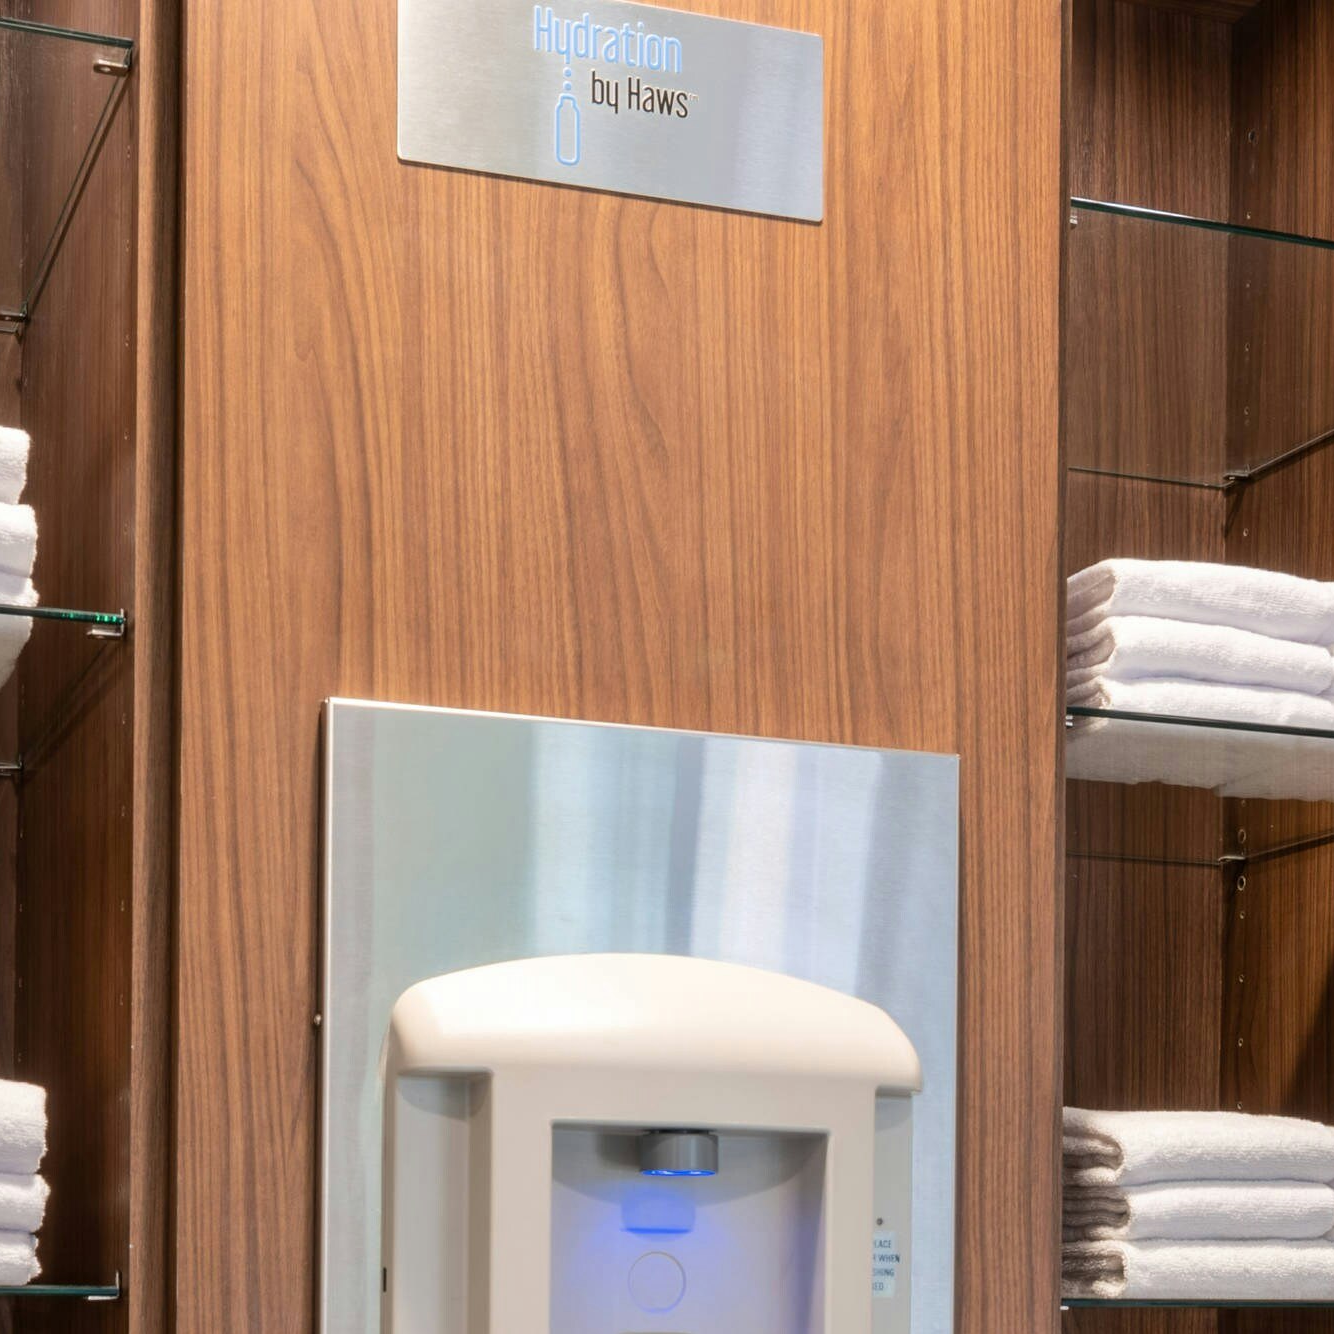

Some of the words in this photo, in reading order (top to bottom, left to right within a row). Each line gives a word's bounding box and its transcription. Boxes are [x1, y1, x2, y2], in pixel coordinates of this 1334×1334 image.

[533, 5, 683, 74] Hydration
[590, 69, 619, 114] by
[878, 1253, 900, 1263] WHEN
